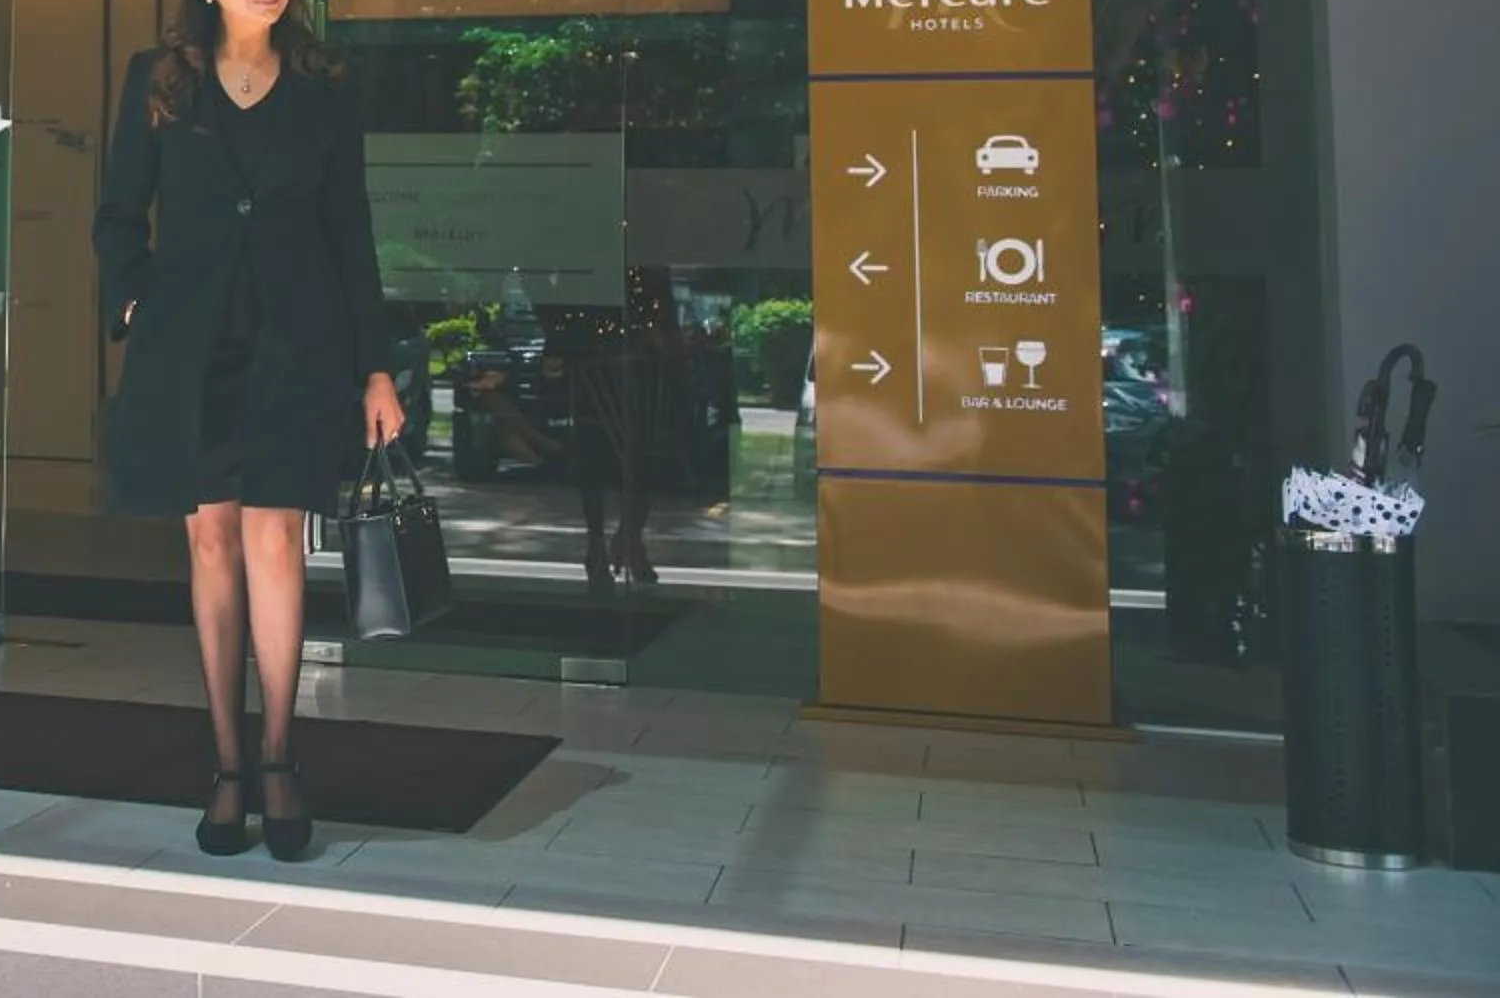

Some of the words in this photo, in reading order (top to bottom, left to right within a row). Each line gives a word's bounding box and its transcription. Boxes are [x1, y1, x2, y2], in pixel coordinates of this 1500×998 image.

[910, 16, 985, 31] HOTELS
[977, 185, 1039, 199] PARKING
[964, 291, 1058, 304] RESTAURANT
[961, 396, 989, 409] BAR
[1005, 396, 1069, 411] LOUNGE
